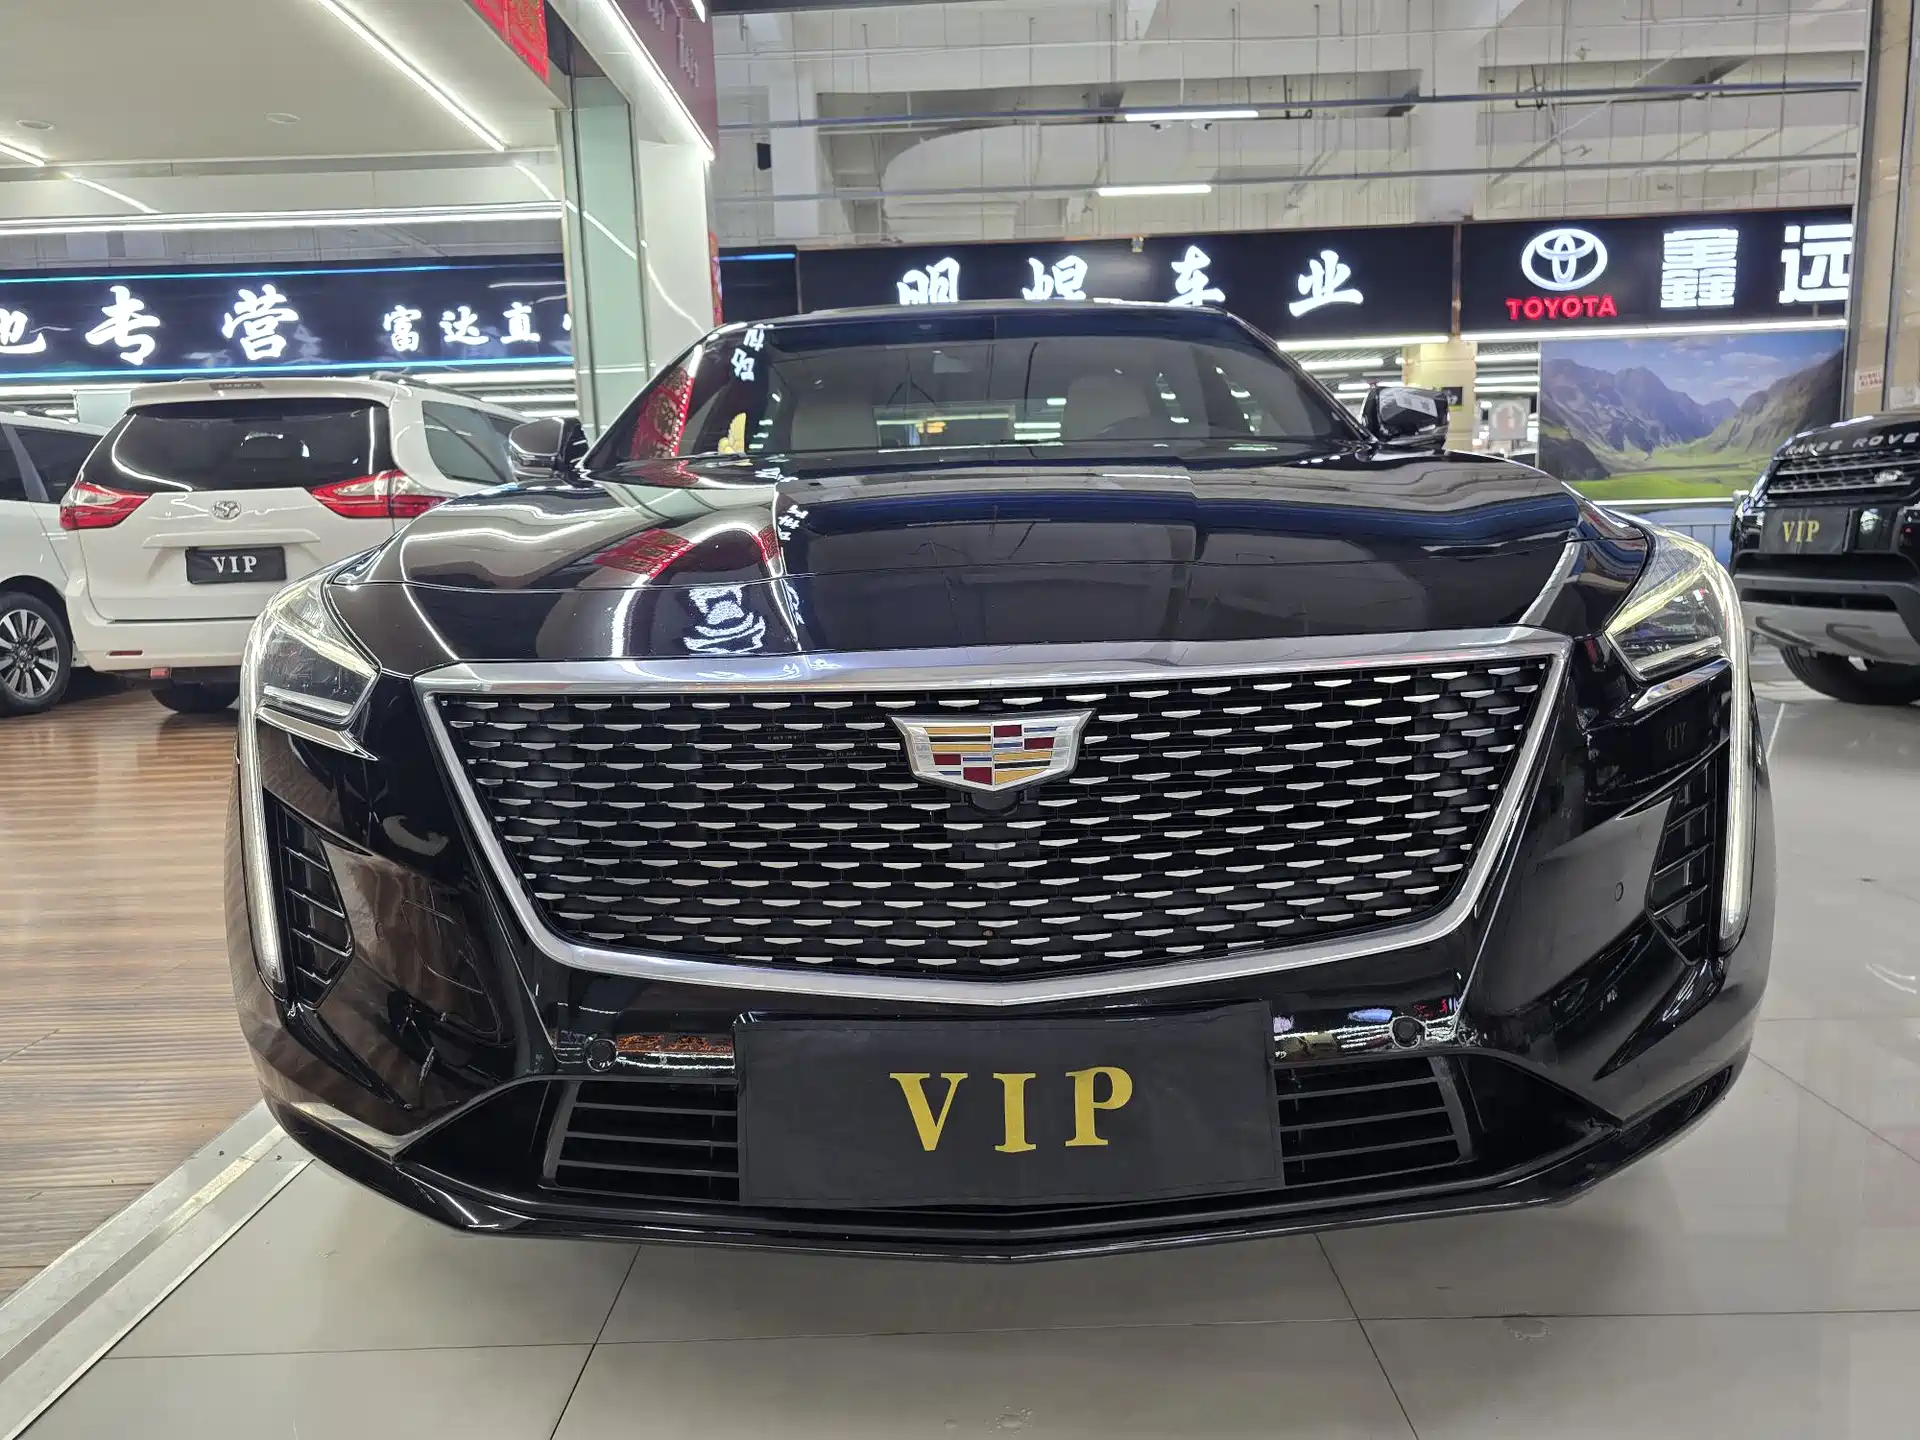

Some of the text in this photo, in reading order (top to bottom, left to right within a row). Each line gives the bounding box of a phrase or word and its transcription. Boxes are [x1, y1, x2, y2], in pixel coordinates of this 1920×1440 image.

[1506, 293, 1618, 321] TOYOTA
[383, 302, 572, 352] 富达直
[1783, 520, 1820, 542] VIP
[211, 555, 257, 573] VIP
[889, 1066, 1134, 1153] VIP
